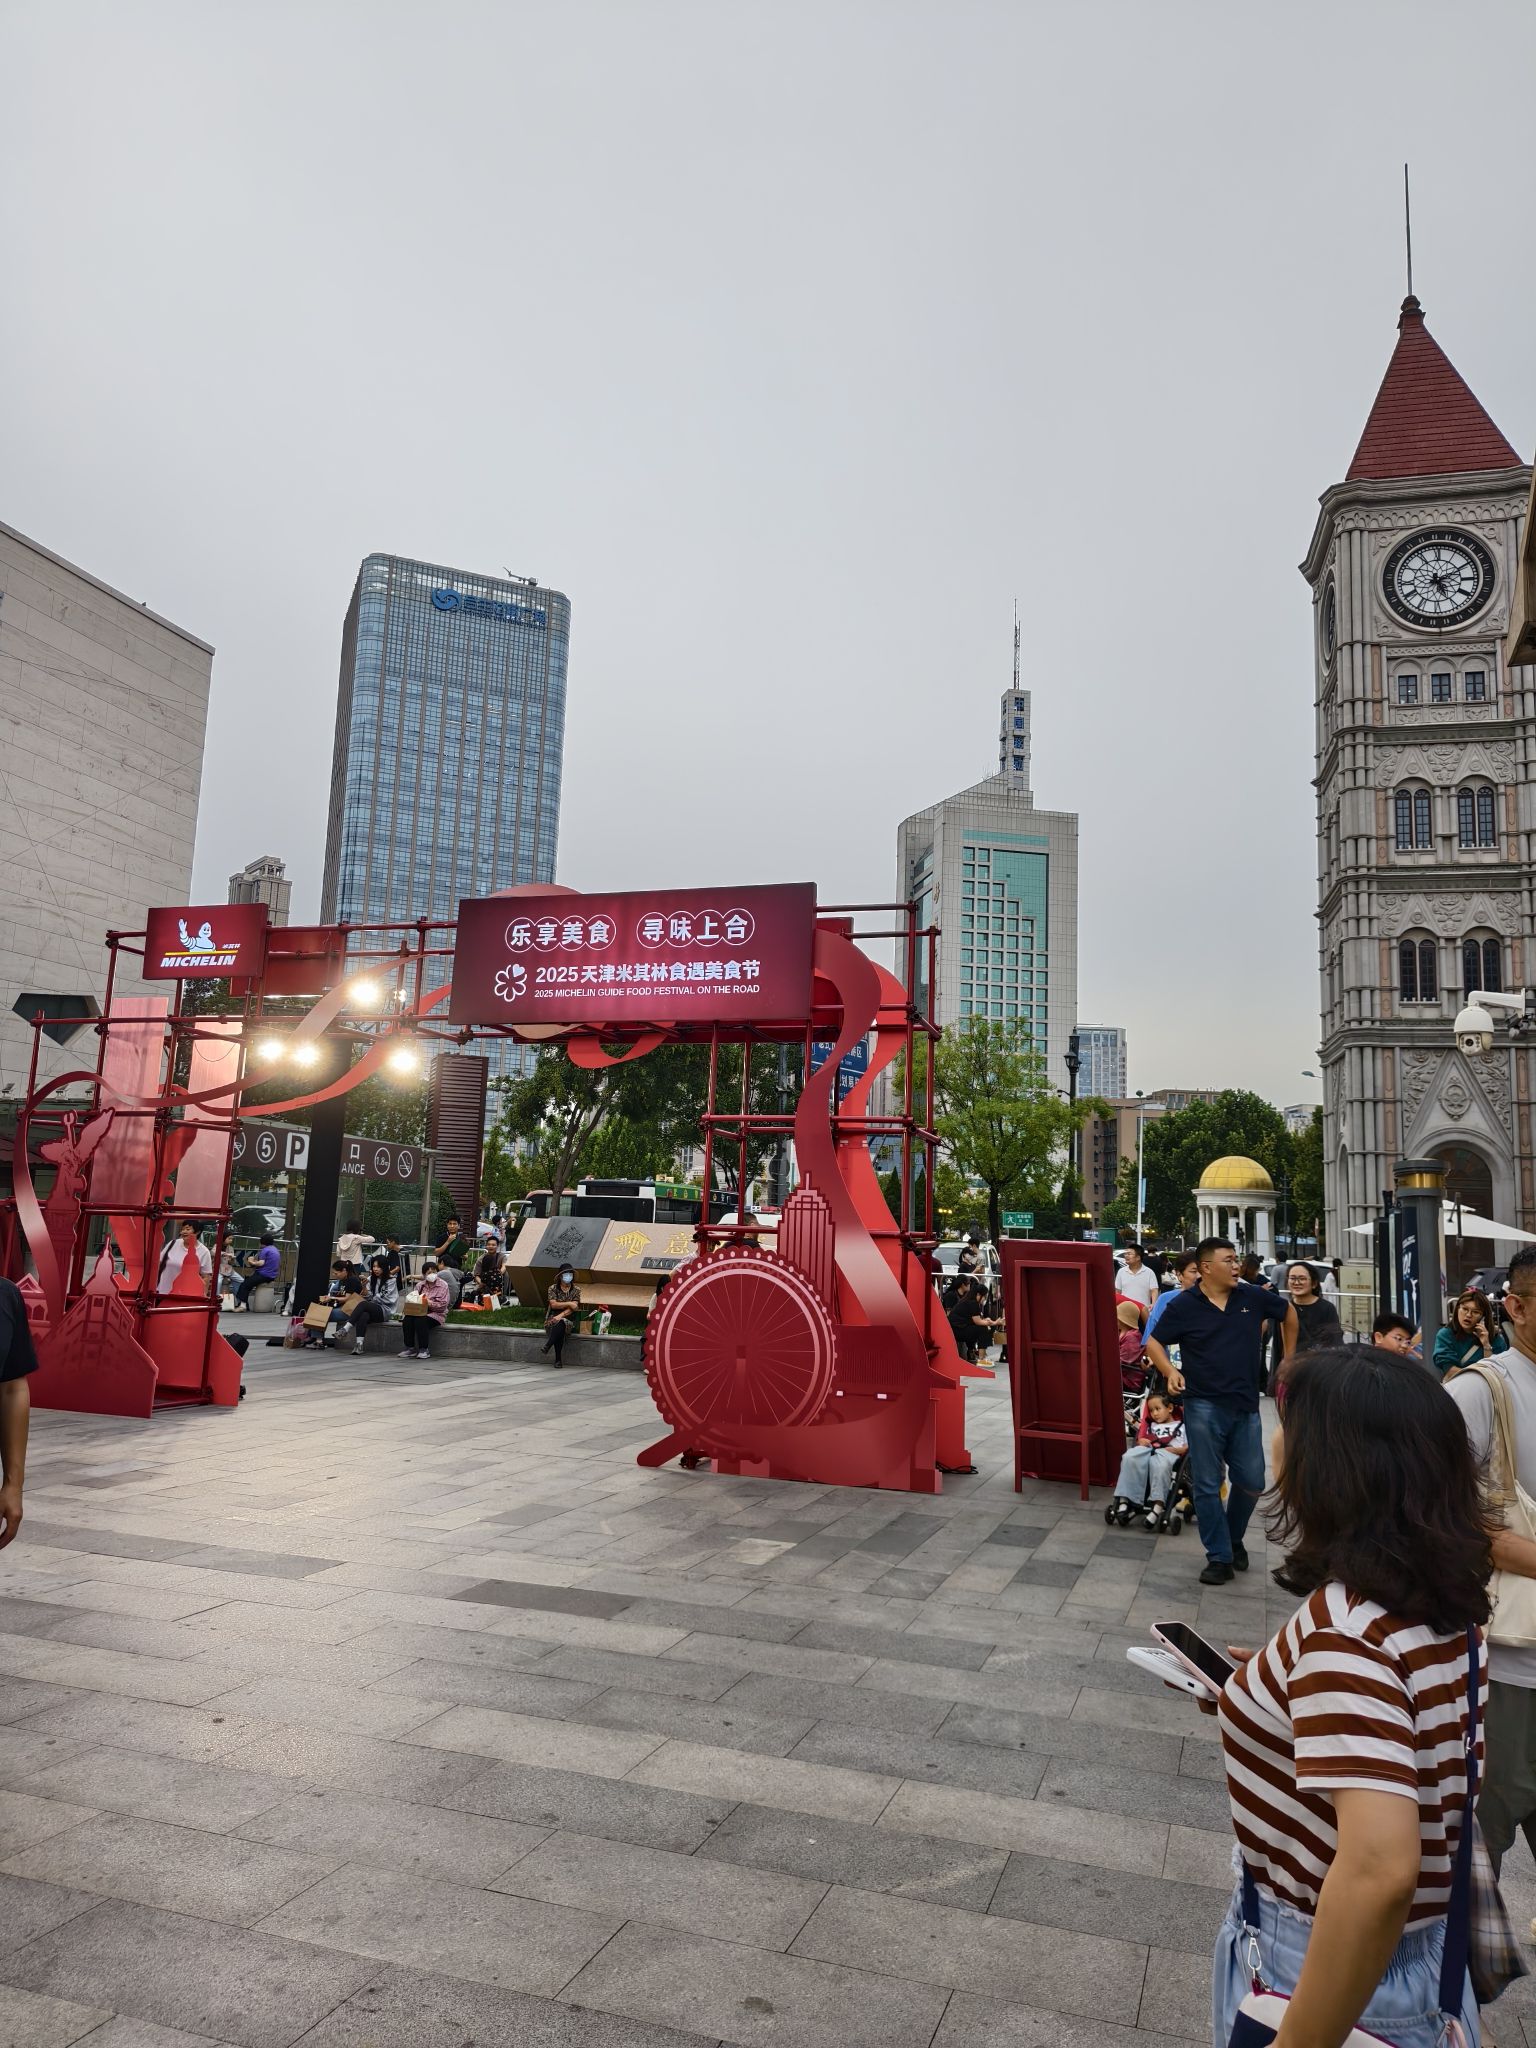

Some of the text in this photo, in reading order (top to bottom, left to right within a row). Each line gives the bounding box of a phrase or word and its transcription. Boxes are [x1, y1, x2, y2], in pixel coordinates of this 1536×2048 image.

[510, 914, 748, 947] 乐享美食 寻味上合
[160, 955, 237, 968] MICHELIN
[535, 960, 761, 984] 2025天津米其林食遇美食节
[534, 984, 760, 998] 2025 MICHELIN GUIDE FOOD FESTIVAL ON THE ROAD
[261, 1137, 272, 1158] 5
[341, 1162, 365, 1175] ANCE
